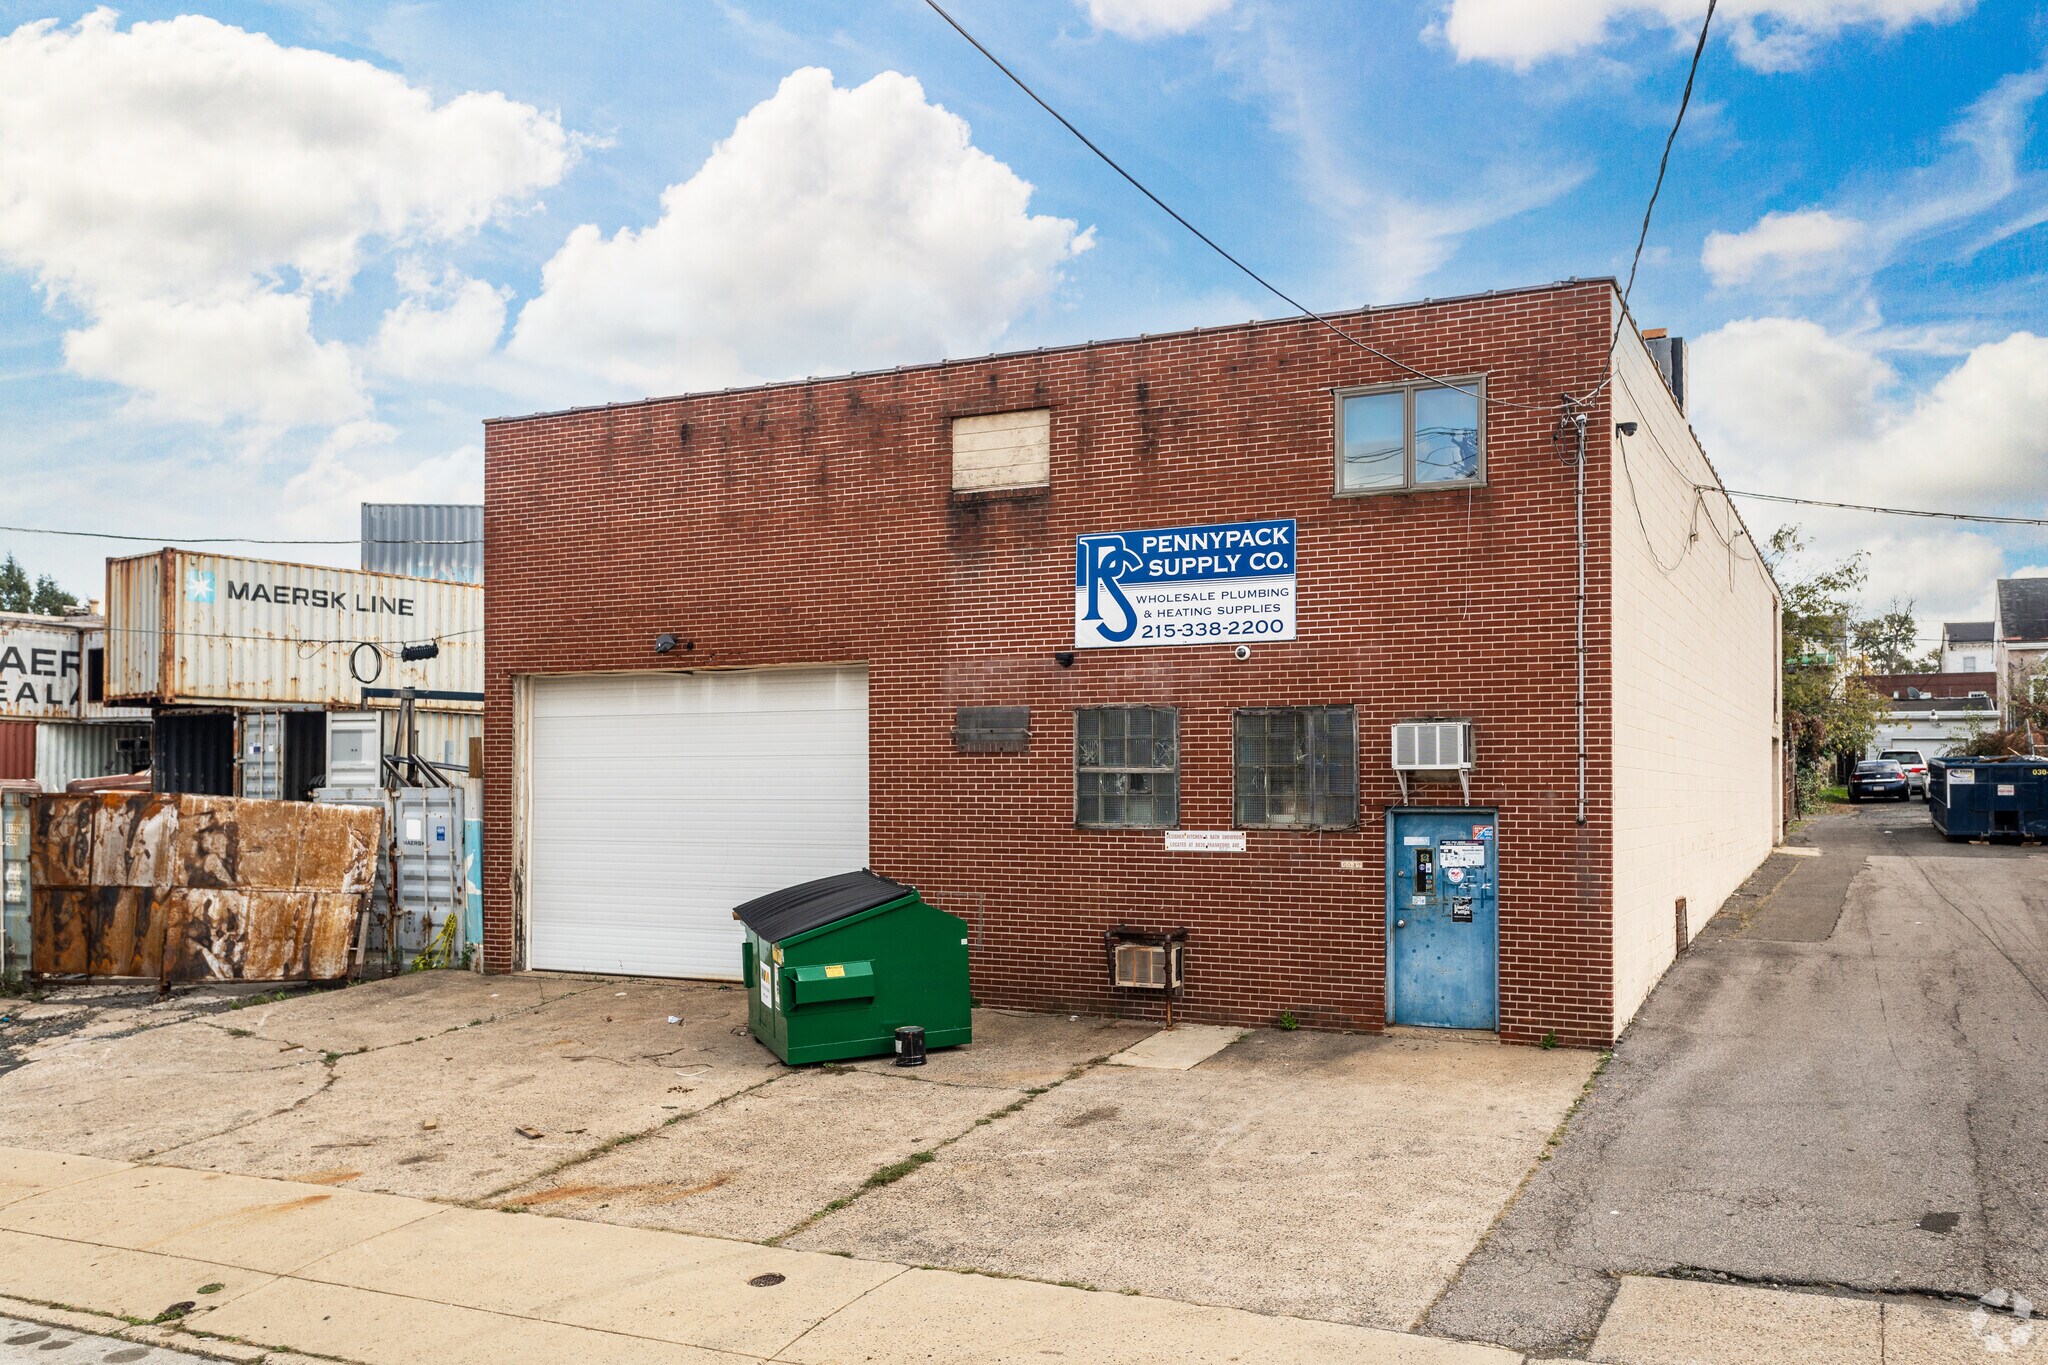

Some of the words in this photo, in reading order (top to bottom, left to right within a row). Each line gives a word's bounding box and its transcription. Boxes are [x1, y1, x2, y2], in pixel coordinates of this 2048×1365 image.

[1142, 526, 1290, 554] PENNYPACK
[1148, 554, 1242, 577] SUPPLY
[1249, 551, 1289, 571] CO.
[227, 580, 347, 611] MAERSK
[356, 594, 414, 617] LINE
[1136, 591, 1216, 604] WHOLESALE
[1221, 587, 1290, 600] PLUMBING
[1143, 610, 1152, 619] &
[1157, 607, 1212, 618] HEATING
[1217, 604, 1281, 615] SUPPLIES
[1141, 619, 1284, 639] 215-338-2200
